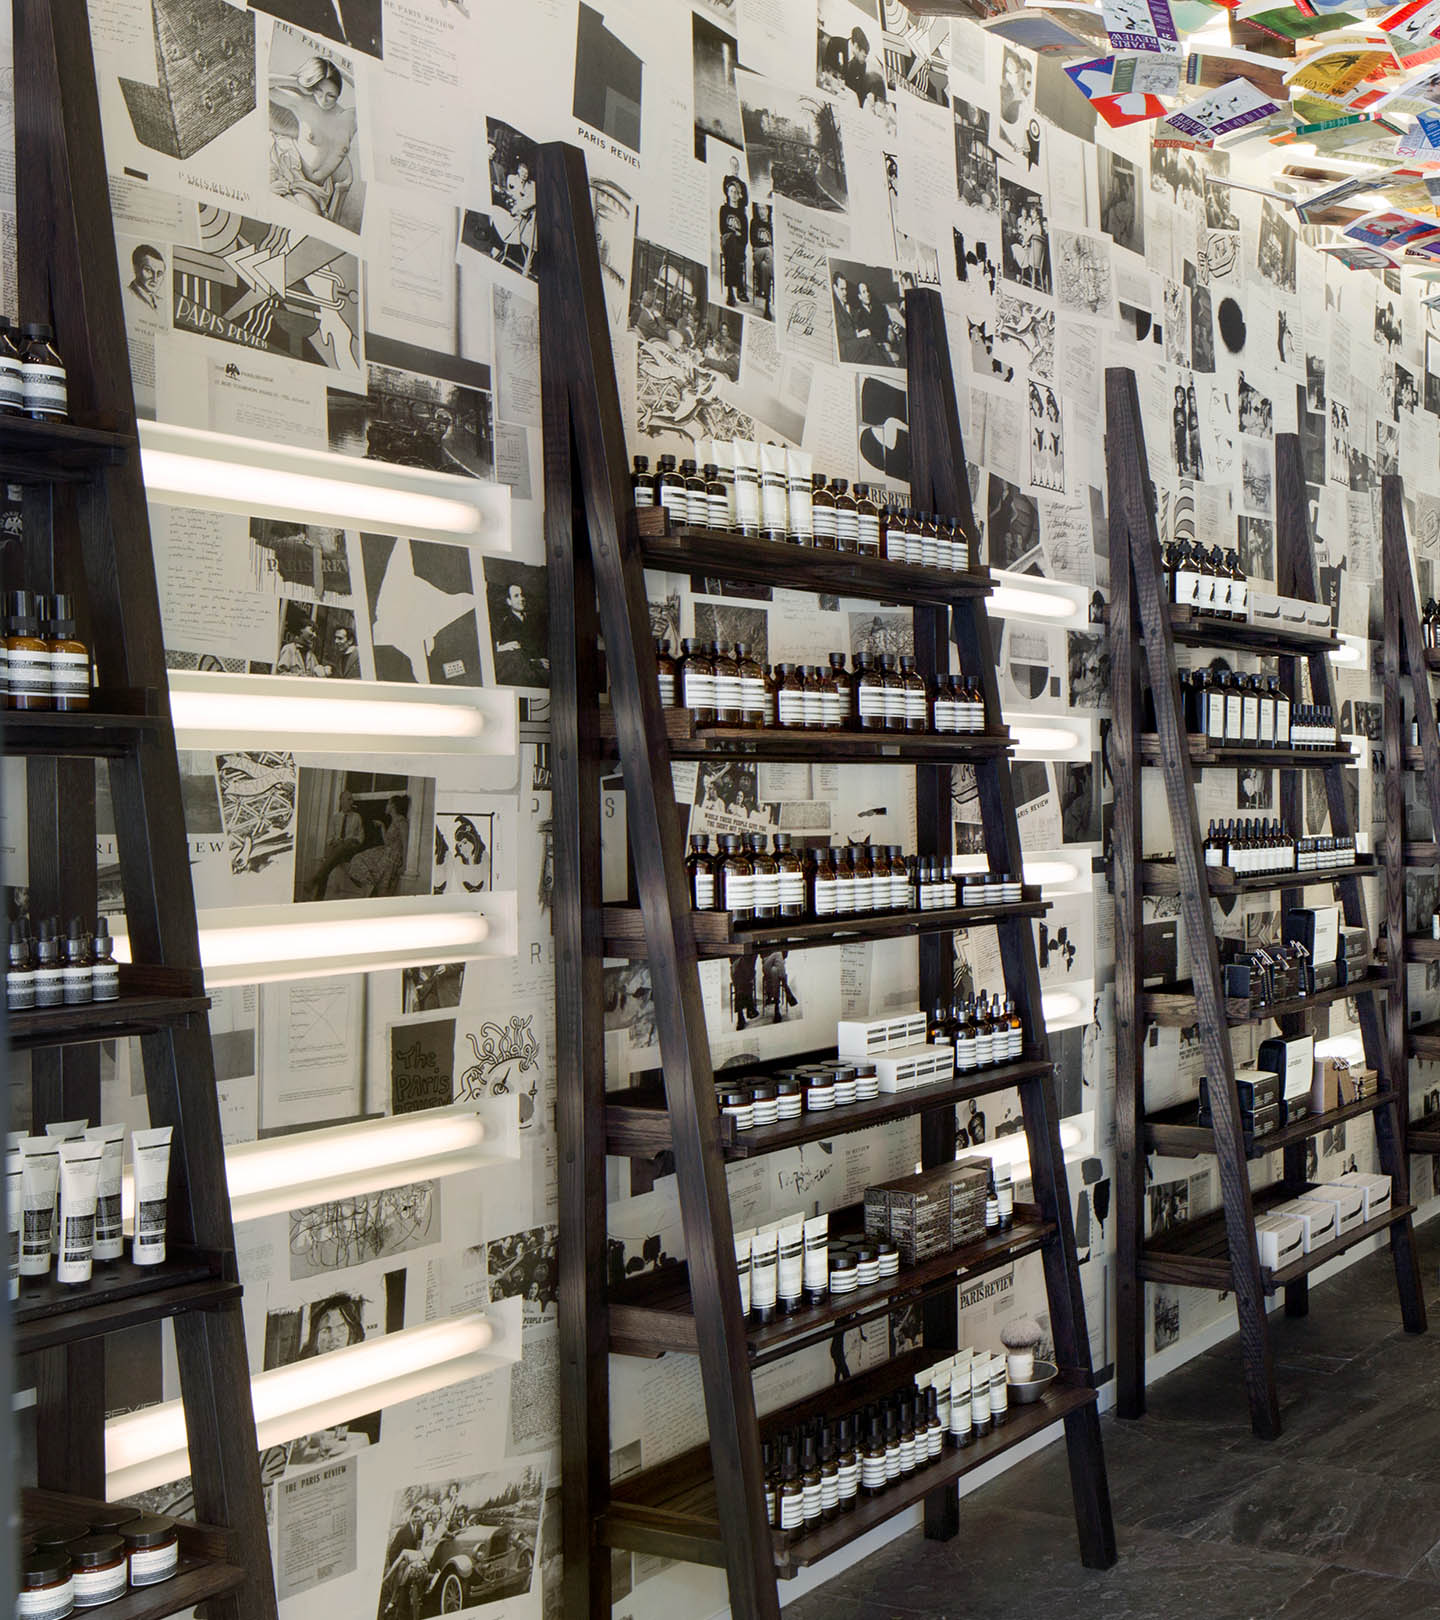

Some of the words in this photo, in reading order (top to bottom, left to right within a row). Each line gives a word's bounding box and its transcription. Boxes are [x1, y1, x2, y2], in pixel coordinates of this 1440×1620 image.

[1110, 32, 1158, 43] REVIEW
[1111, 40, 1147, 50] PARIS
[577, 127, 606, 150] PARIS
[175, 295, 225, 335] PARIS
[227, 322, 269, 350] REVIEW
[285, 1482, 297, 1495] THE
[301, 1473, 321, 1489] PARIS
[323, 1464, 347, 1481] REVIEW
